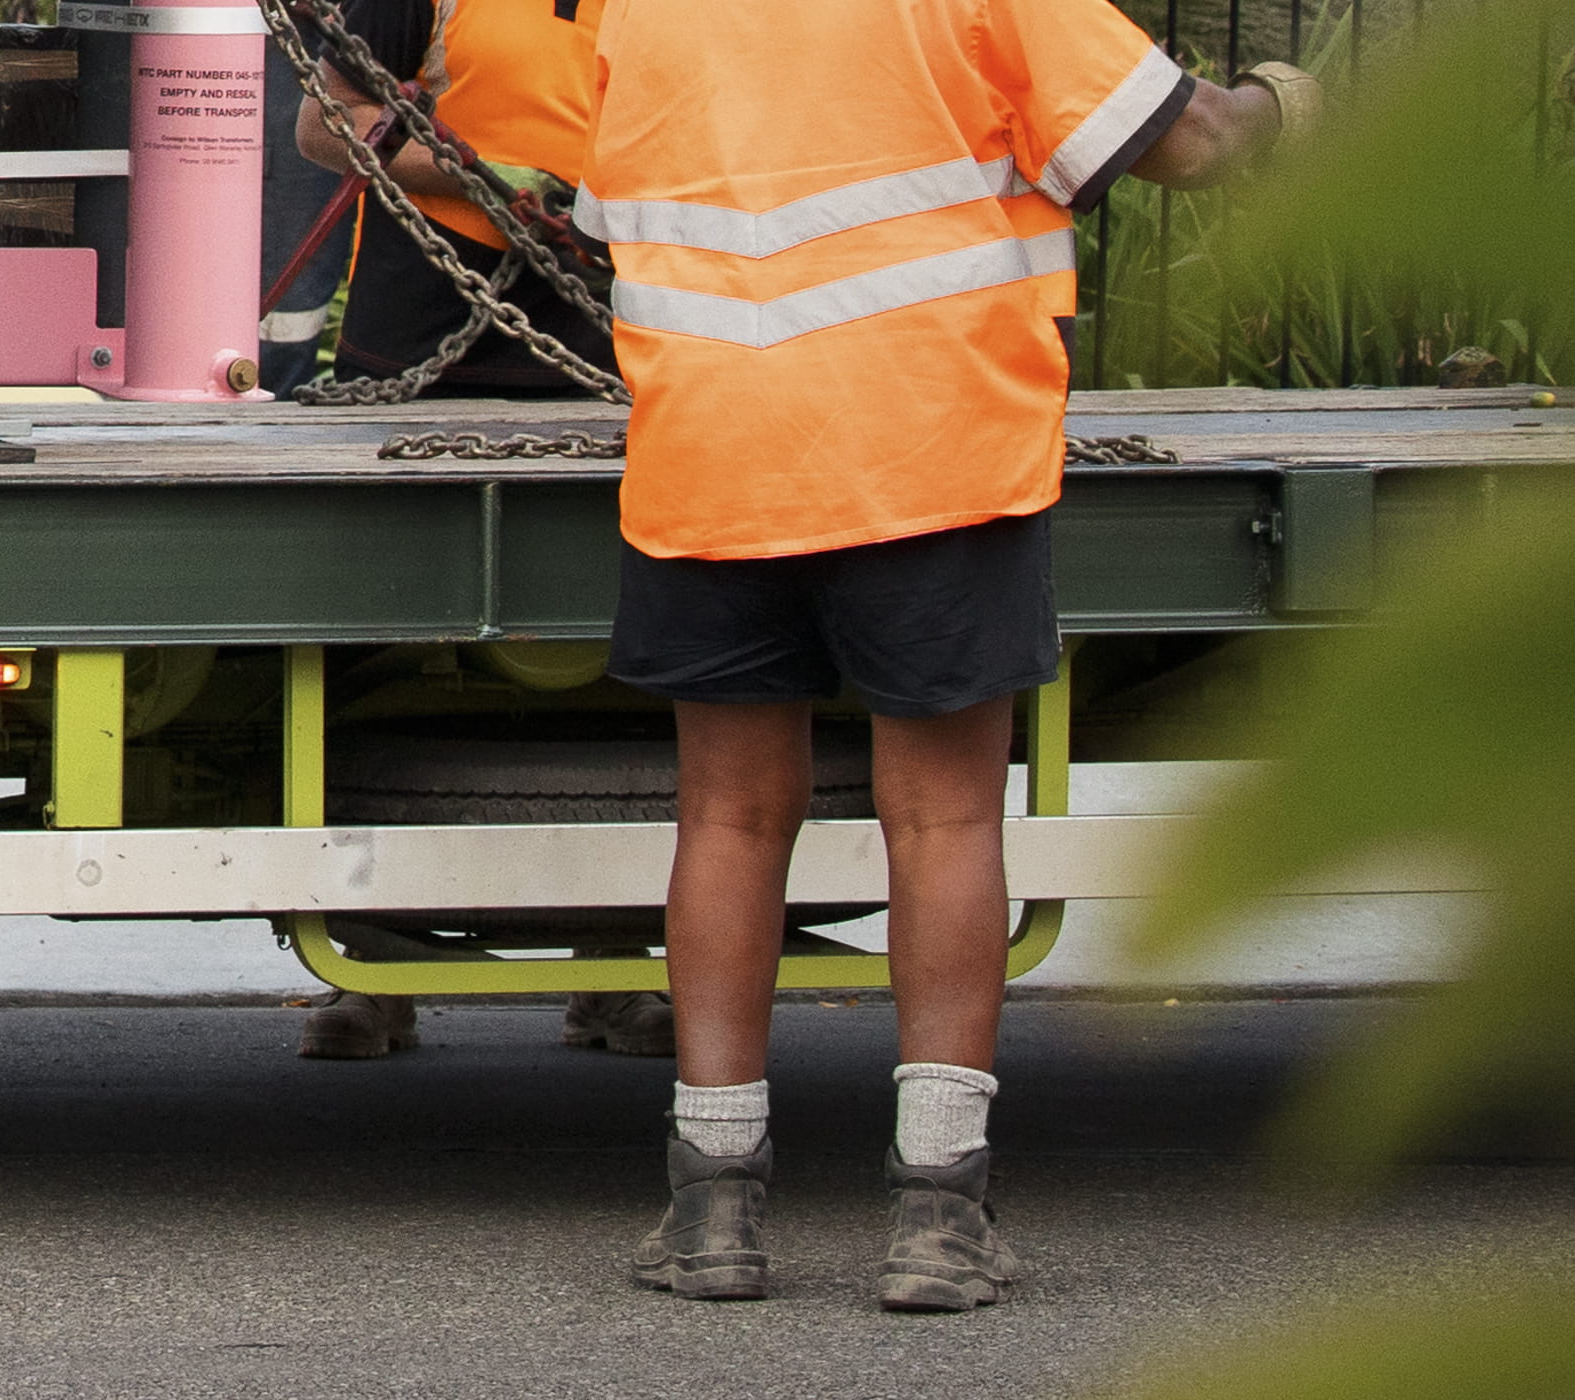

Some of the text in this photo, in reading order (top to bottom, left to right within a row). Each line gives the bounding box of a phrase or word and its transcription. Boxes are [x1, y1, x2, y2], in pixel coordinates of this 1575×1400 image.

[156, 68, 183, 79] PART
[185, 70, 233, 80] NUMBER
[160, 88, 197, 98] EMPTY
[200, 89, 223, 99] AND
[158, 106, 201, 117] BEFORE
